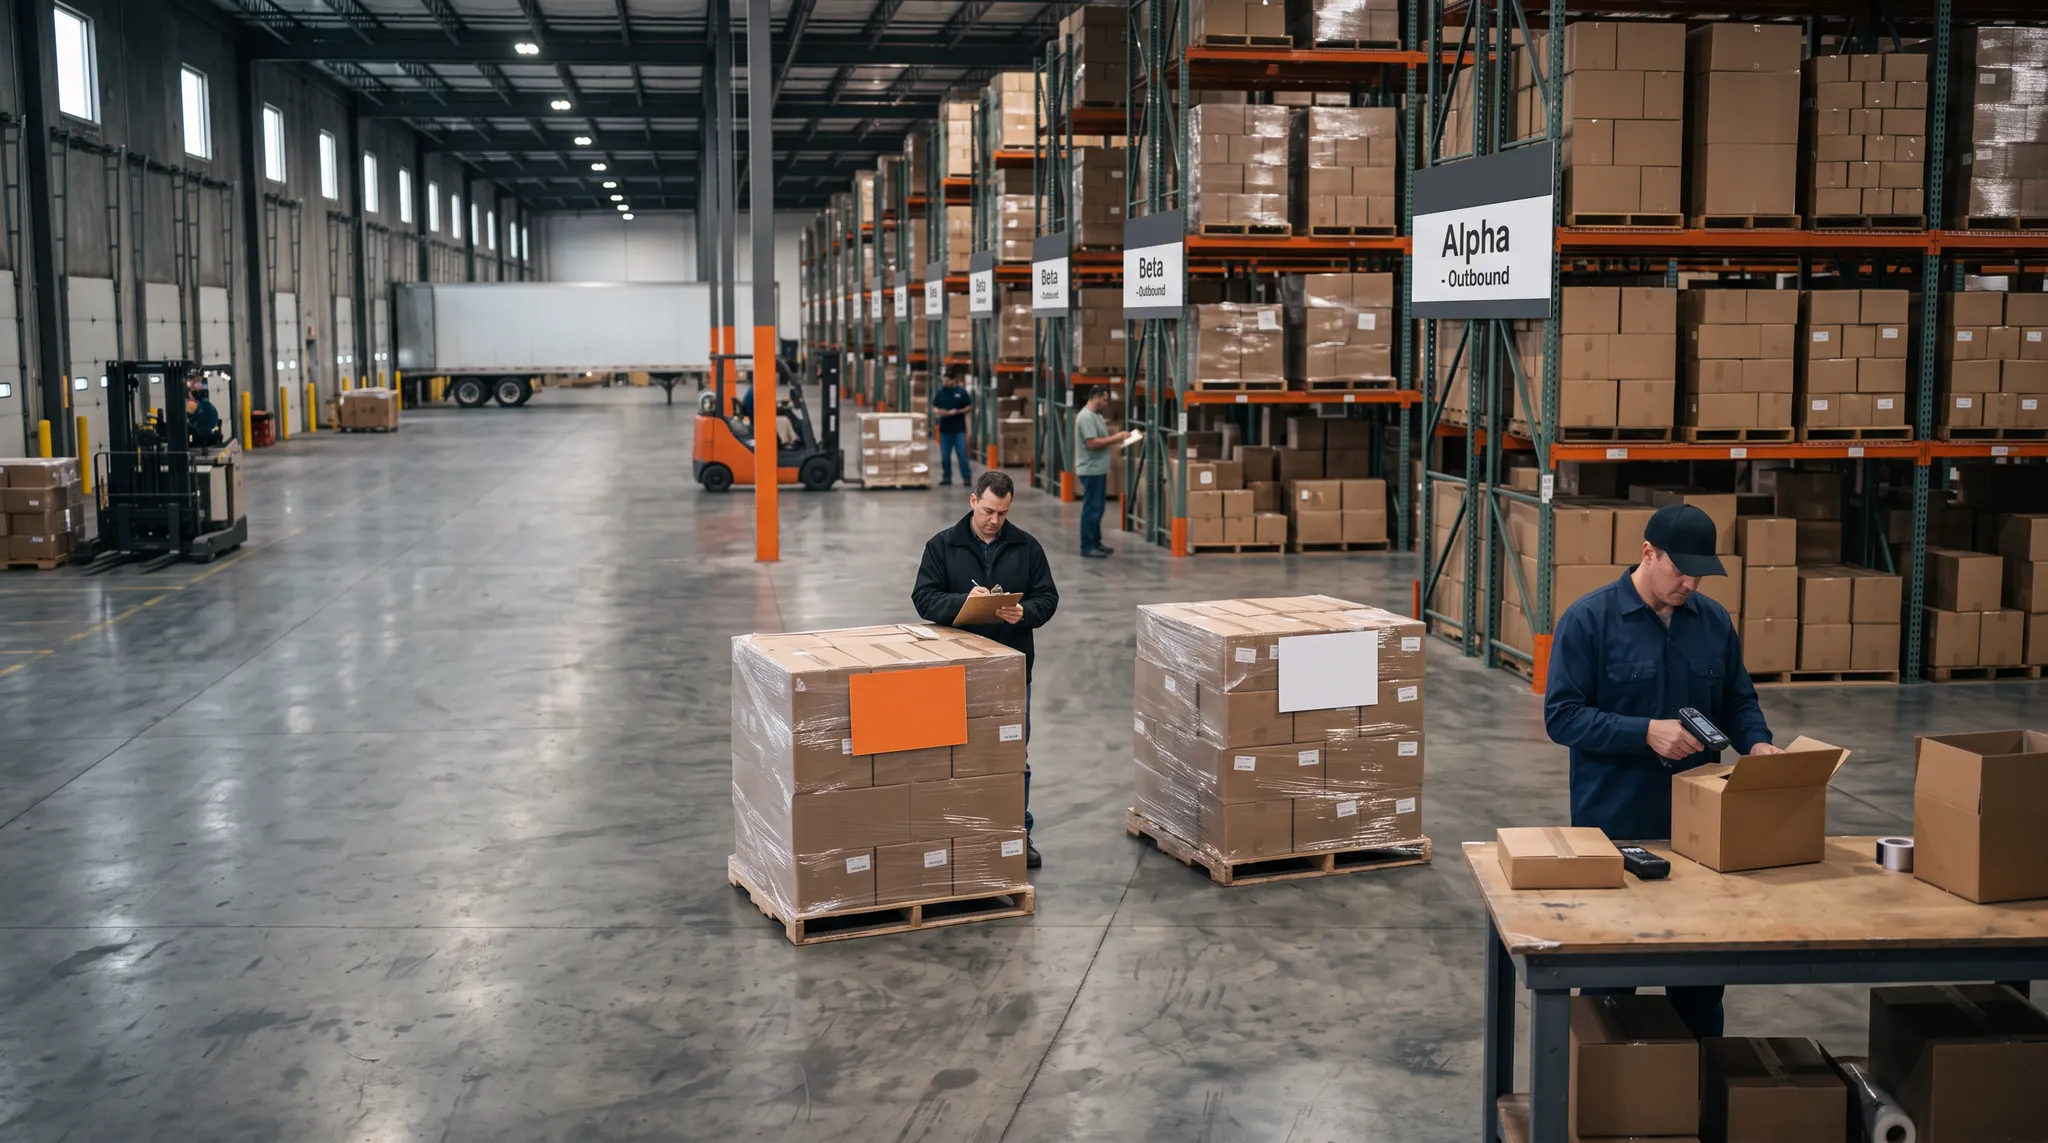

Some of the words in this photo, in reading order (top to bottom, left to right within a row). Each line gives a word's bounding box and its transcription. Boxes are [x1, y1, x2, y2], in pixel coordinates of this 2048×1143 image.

[1441, 219, 1510, 265] Alpha
[1041, 269, 1058, 285] Beta
[1139, 257, 1163, 279] Beta
[1448, 265, 1510, 287] Outbound
